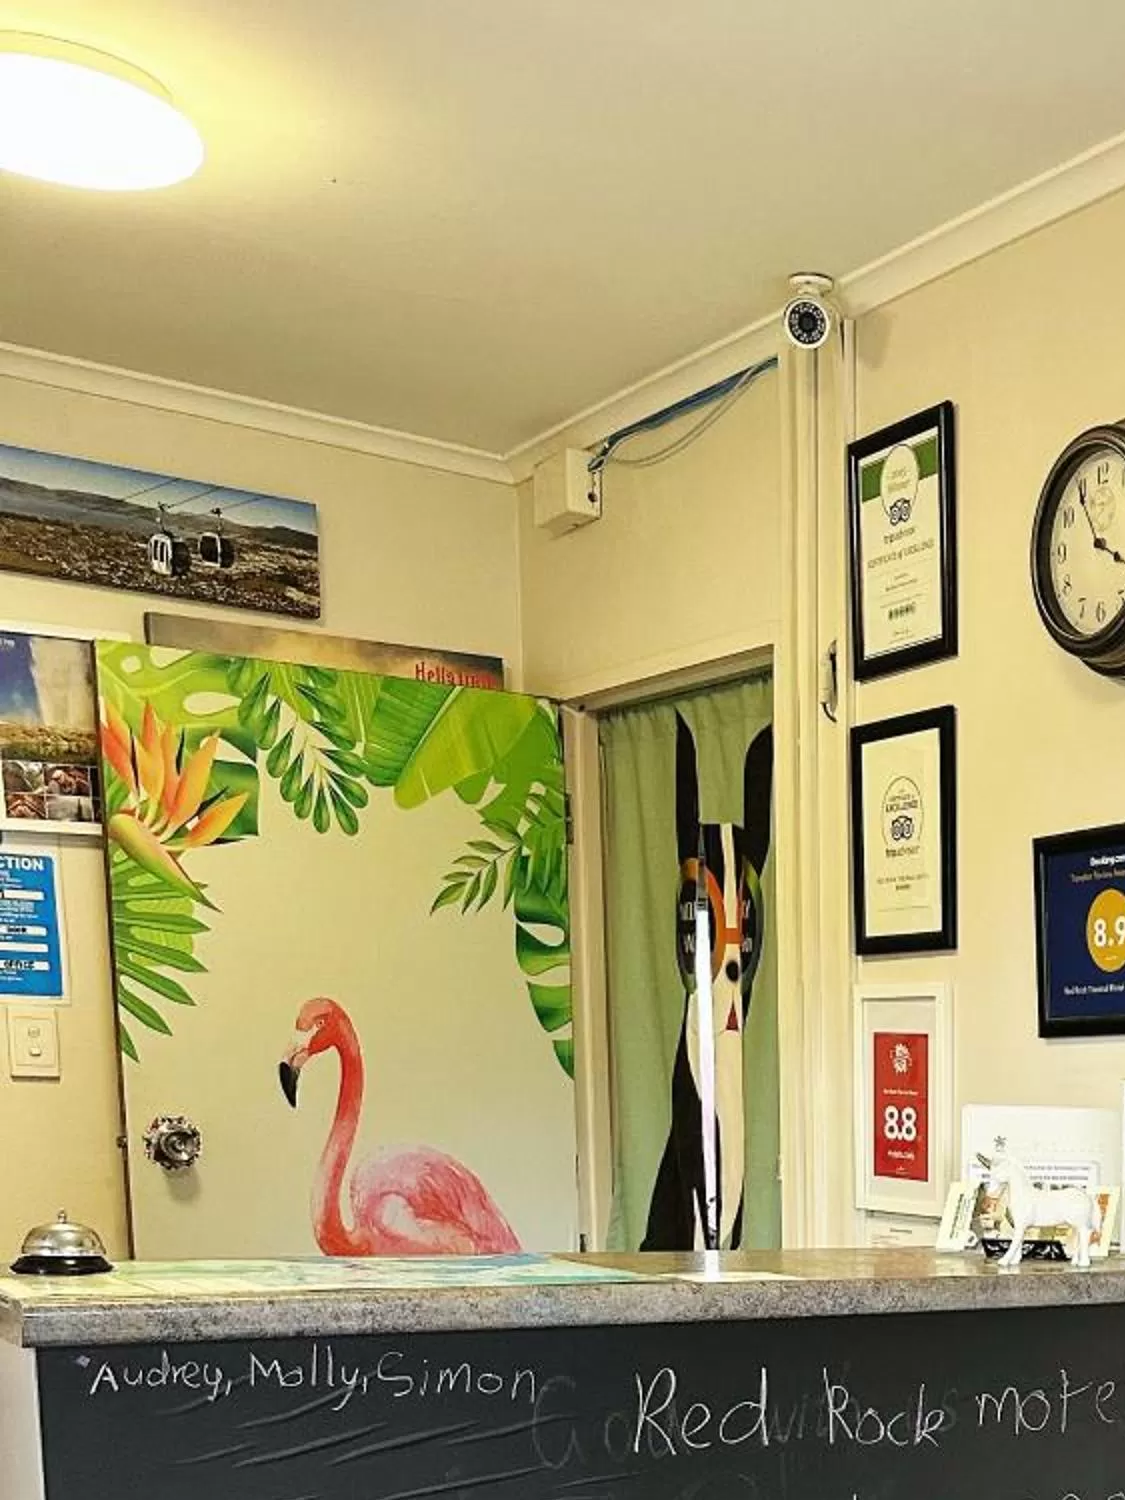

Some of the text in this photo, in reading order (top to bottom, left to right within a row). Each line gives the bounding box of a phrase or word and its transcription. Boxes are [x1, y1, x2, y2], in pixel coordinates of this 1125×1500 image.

[884, 1104, 917, 1142] 8.8
[376, 1351, 536, 1403] Simon
[635, 1367, 771, 1457] Red
[824, 1366, 945, 1447] Rock
